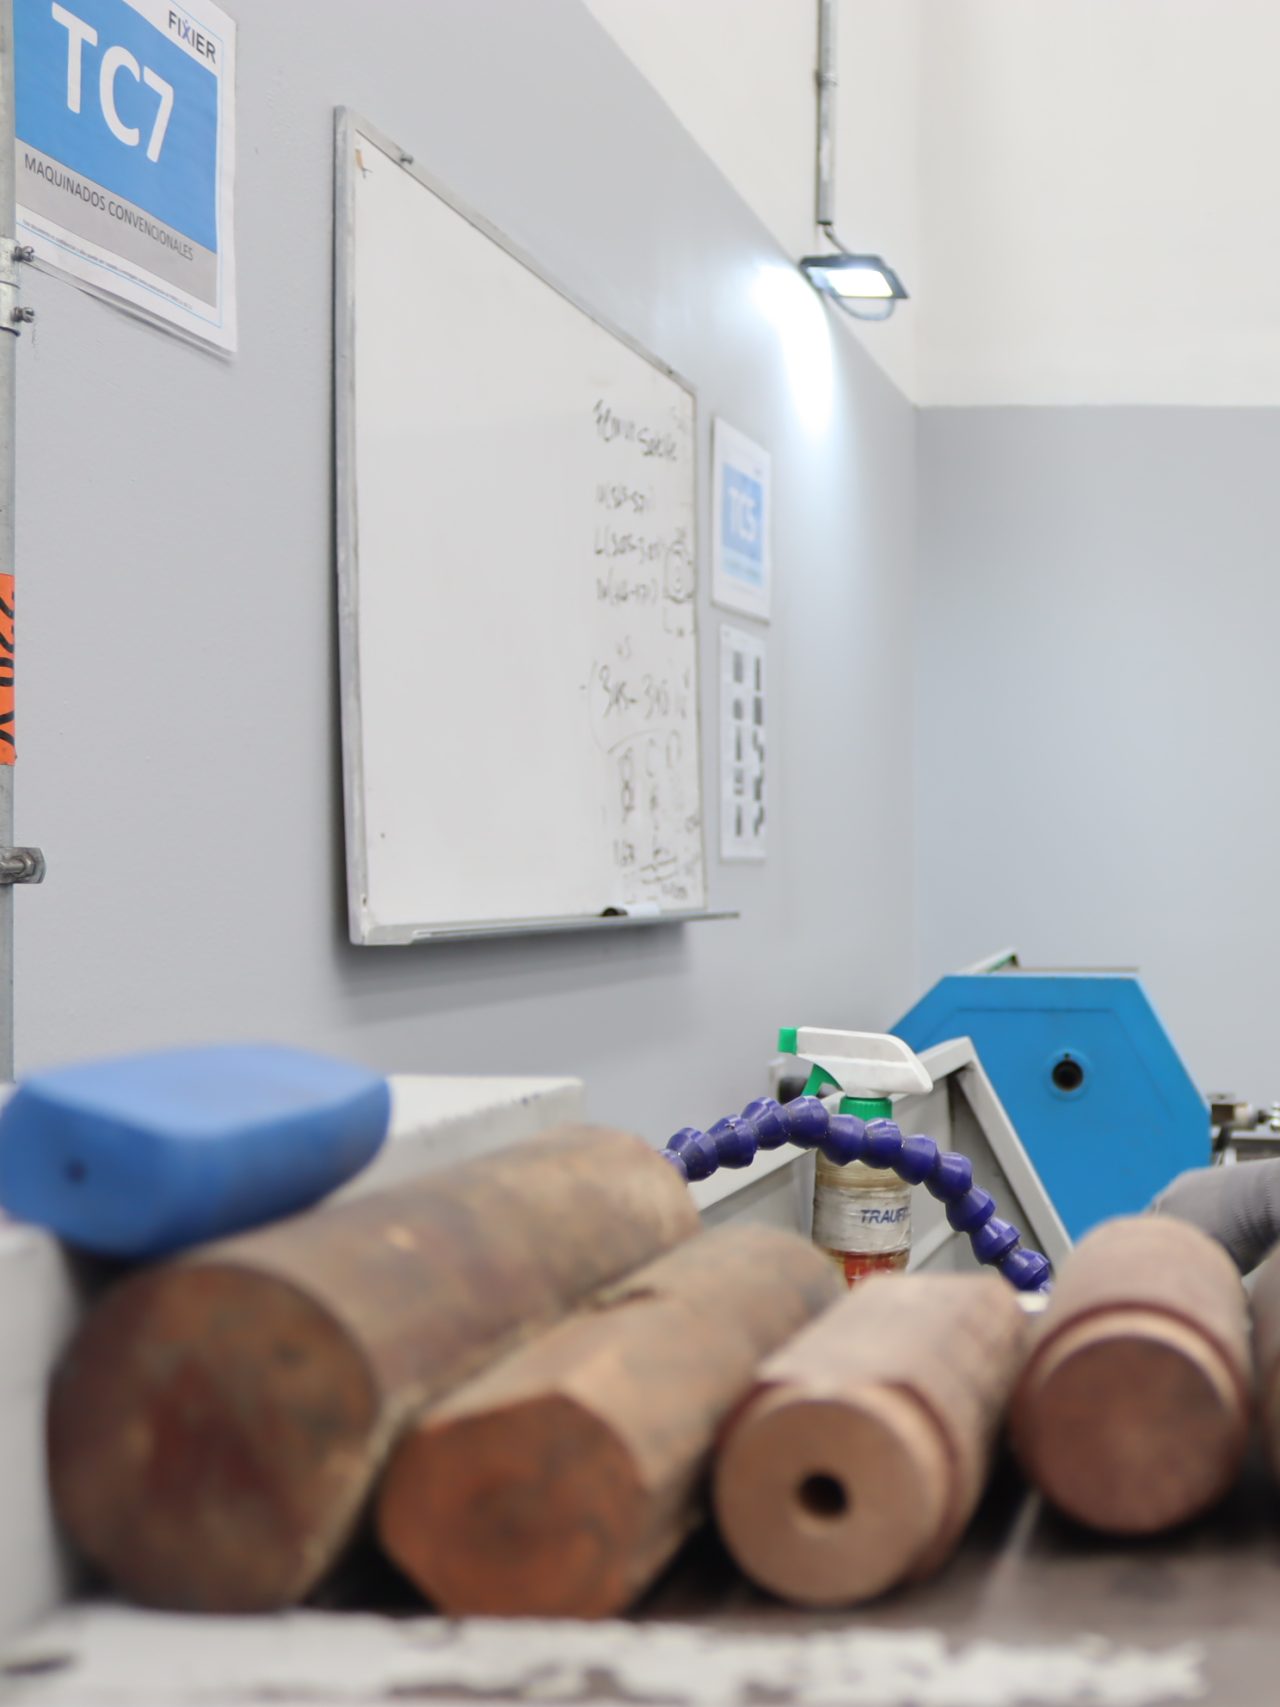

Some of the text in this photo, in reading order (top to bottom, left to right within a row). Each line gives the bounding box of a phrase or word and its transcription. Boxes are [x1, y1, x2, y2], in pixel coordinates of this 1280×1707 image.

[52, 2, 175, 163] TC7
[168, 9, 216, 65] FIXIER
[24, 152, 194, 261] MAQUINADOS CONVENCIONALES
